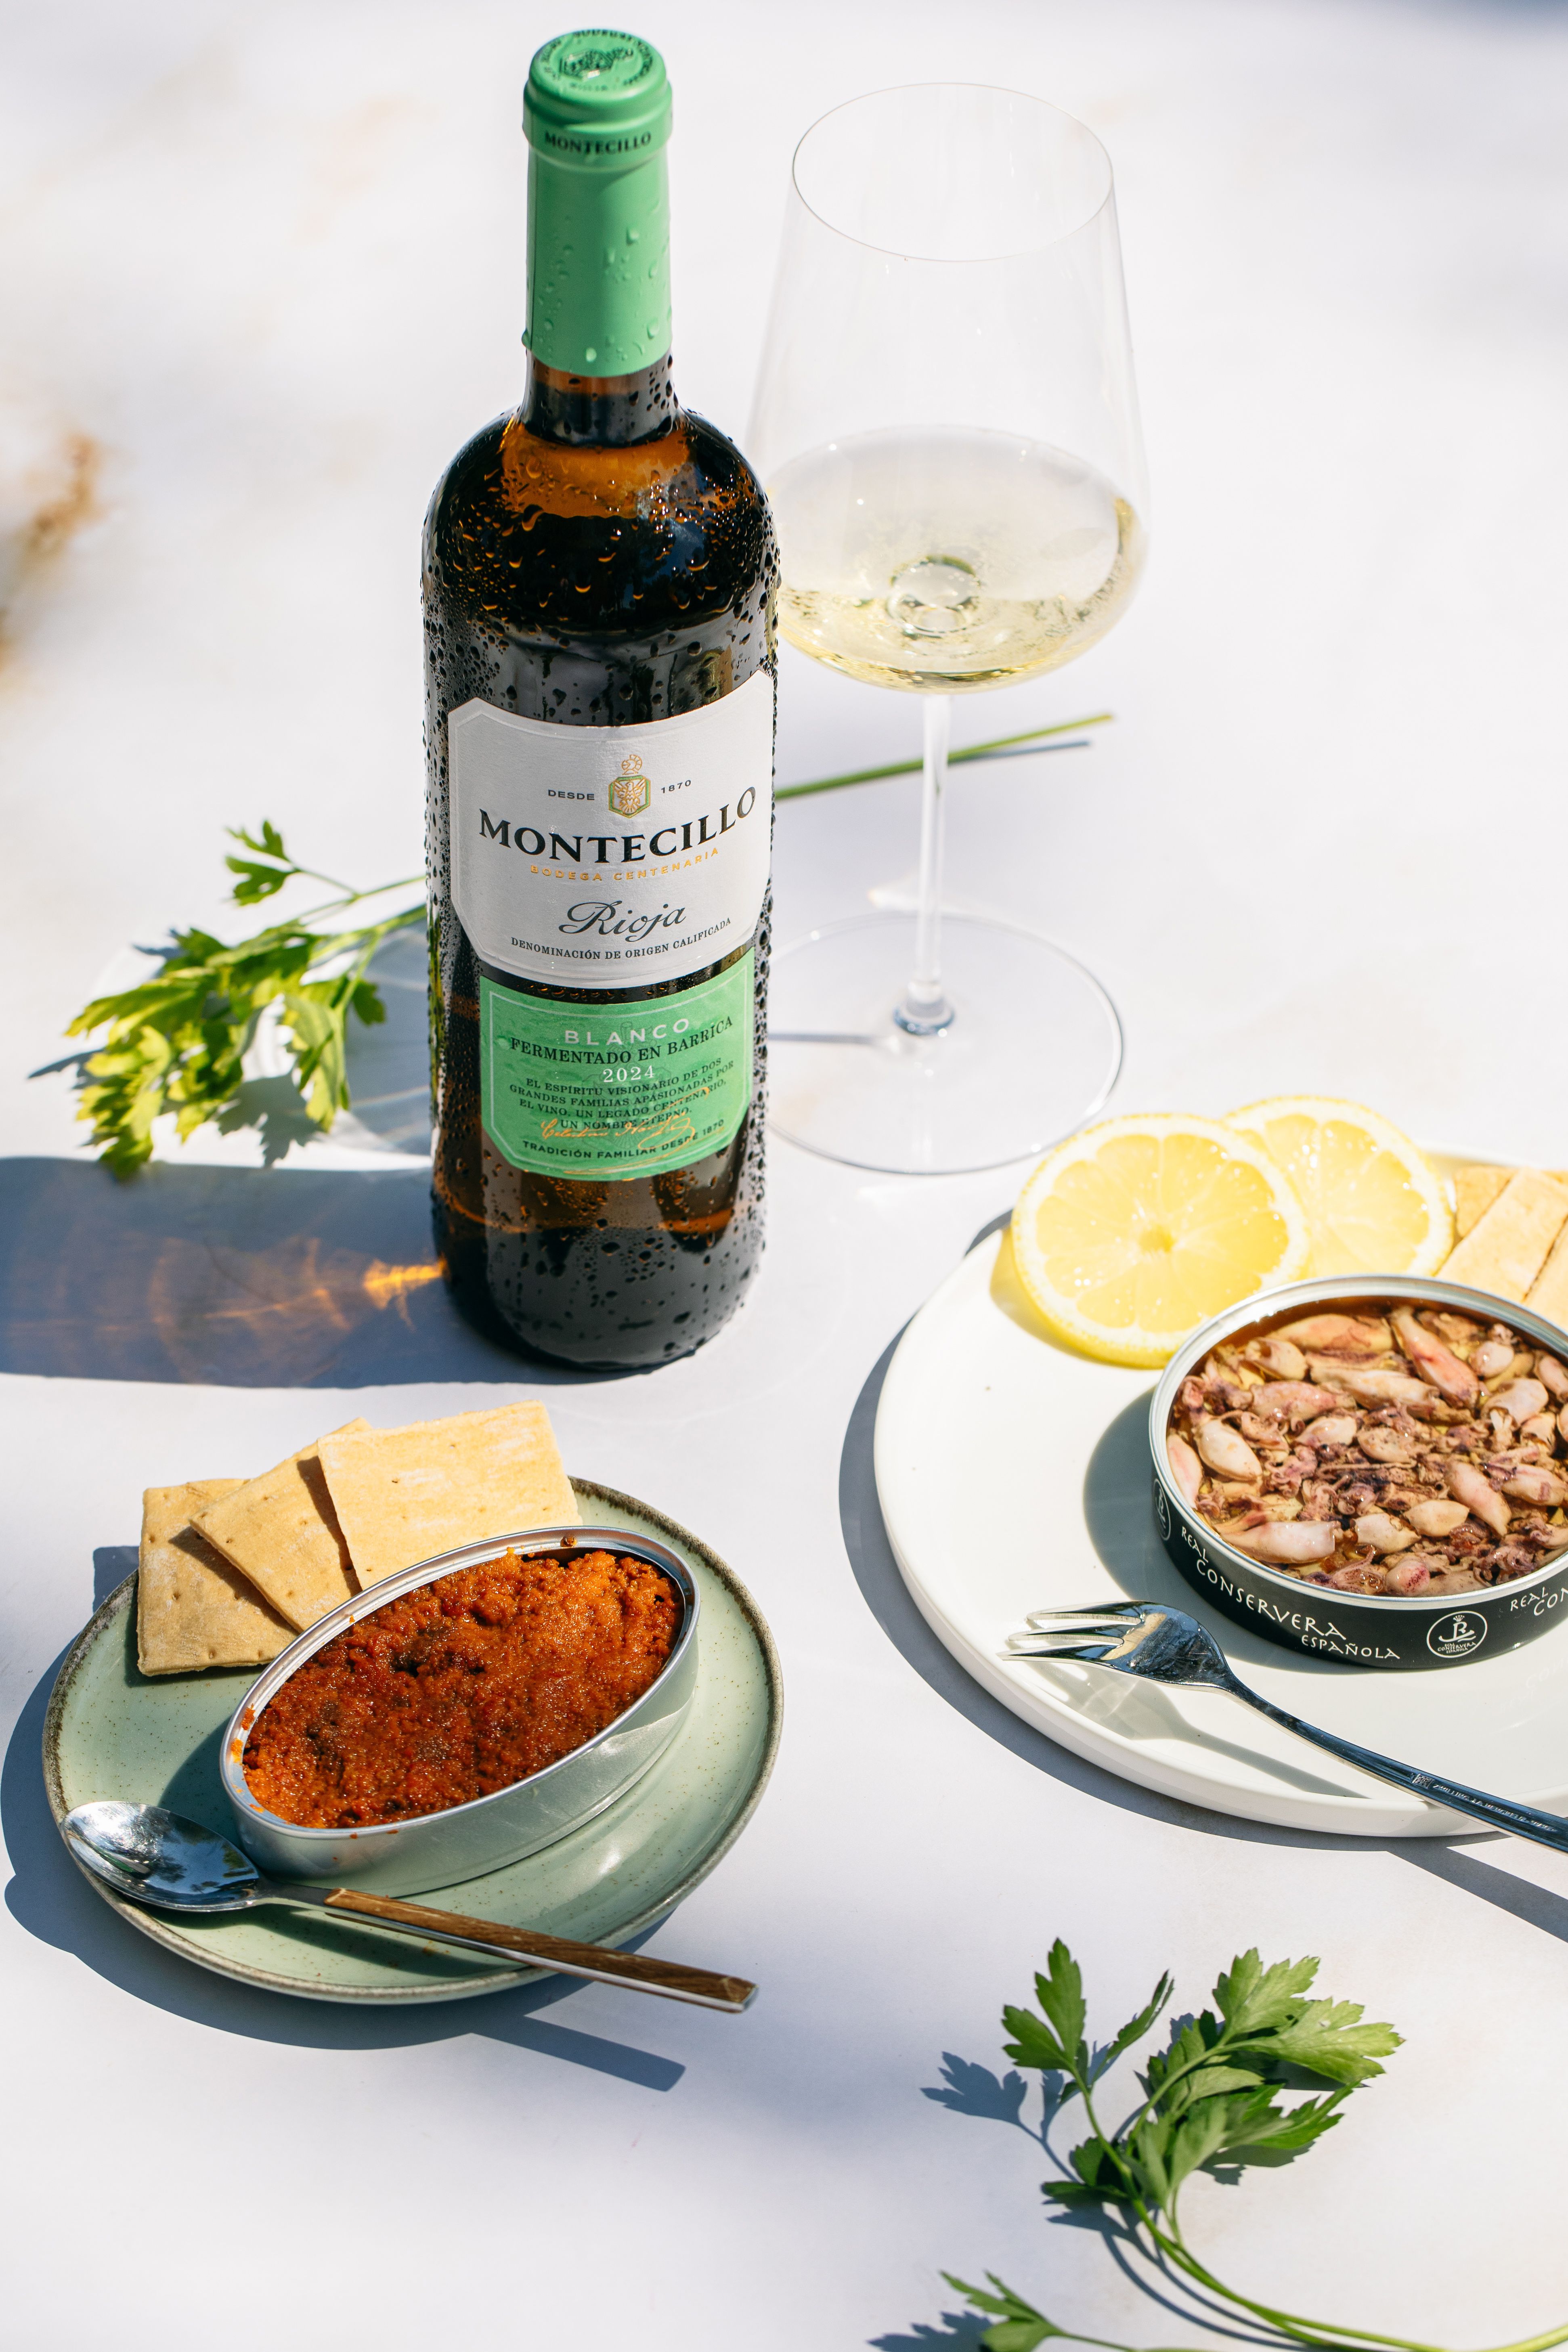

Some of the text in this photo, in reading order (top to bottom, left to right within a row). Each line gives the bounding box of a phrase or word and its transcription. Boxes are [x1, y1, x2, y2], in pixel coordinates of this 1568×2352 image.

[545, 130, 651, 155] MONTECILLO
[548, 779, 692, 801] DESDE 1870
[479, 786, 756, 863] MONTECILLO
[530, 848, 719, 881] BODEGA CENTENARIA
[559, 901, 686, 942] Rioja
[511, 917, 731, 960] DENOMINACIÓN DE ORIGEN CALIFICADA
[511, 1016, 733, 1064] FERMENTADO EN BARRICA
[565, 1018, 689, 1045] BLANCO
[510, 1061, 734, 1107] GRANDES FAMILIAS APASIONADAS POR
[526, 1058, 721, 1095] EL ESPÍRITU VISIONARIO DE DOS
[603, 1065, 655, 1082] 2024
[520, 1098, 534, 1109] EL
[599, 1107, 648, 1118] LEGADO
[561, 1119, 577, 1129] UN
[523, 1119, 724, 1158] TRADICIÓN FAMILIAR DESDE 1870
[1182, 1526, 1208, 1563] REAL
[1197, 1560, 1346, 1640] CONSERVERA
[1511, 1587, 1548, 1611] REAL
[1301, 1635, 1400, 1660] ESPAÑOLA
[1438, 1641, 1476, 1651] CONSERVERA
